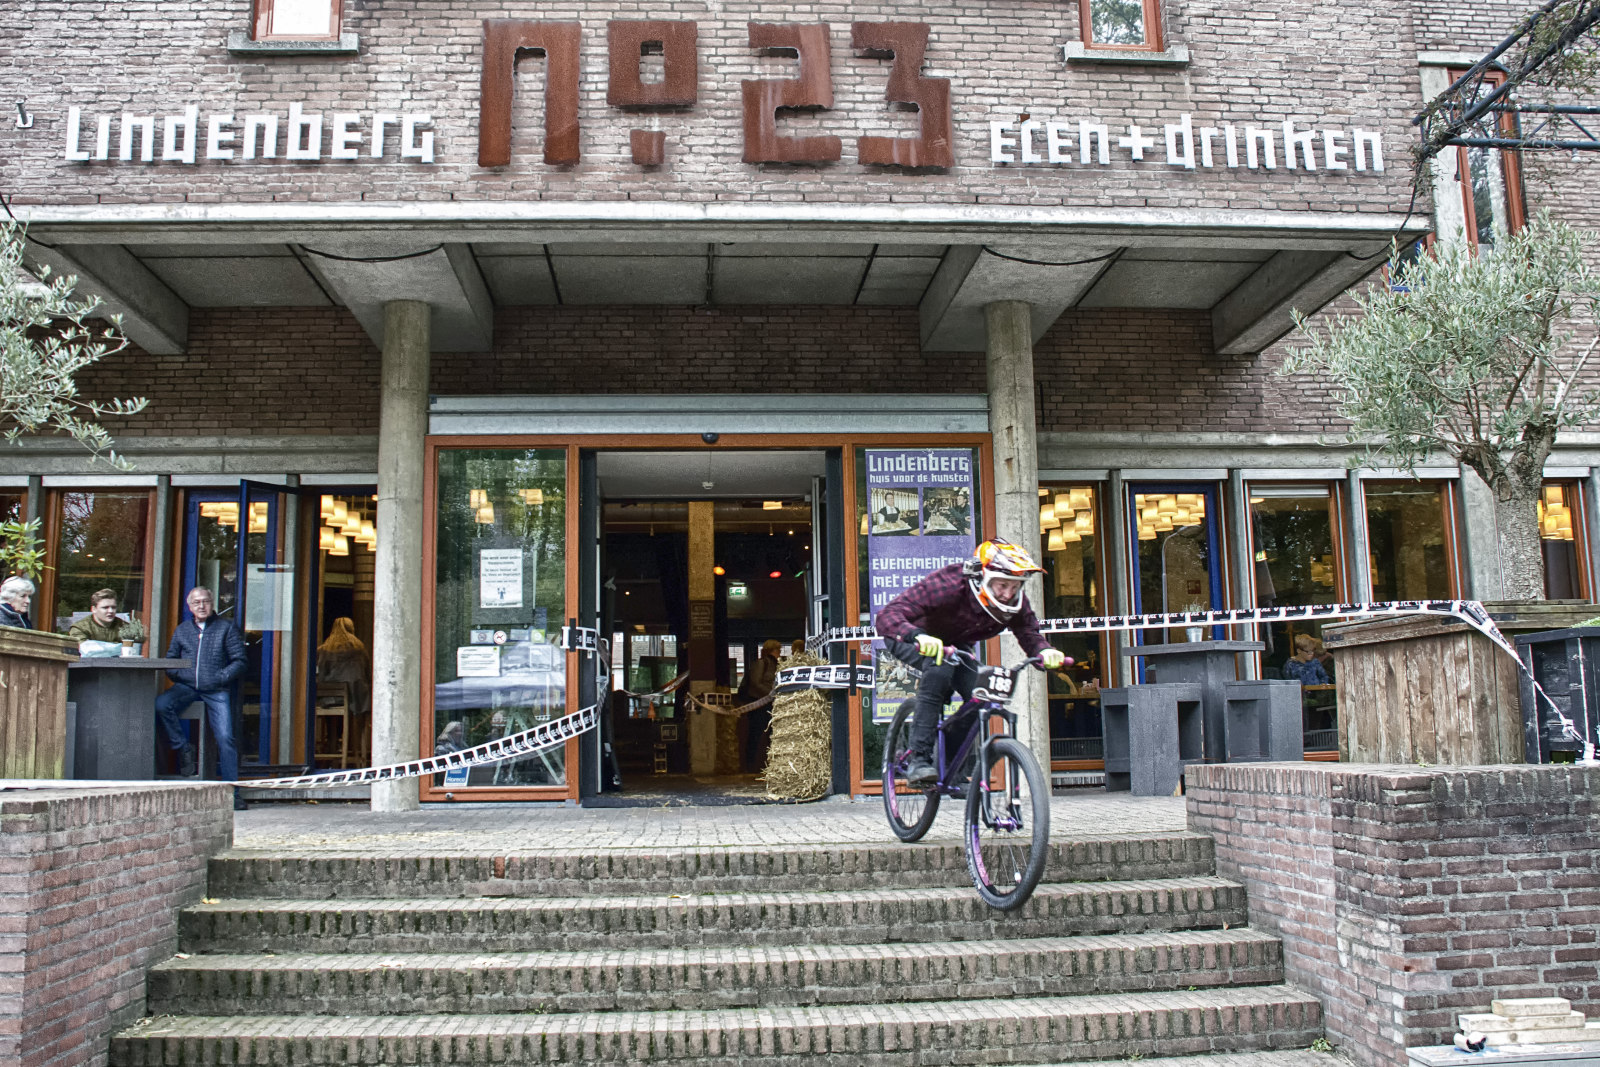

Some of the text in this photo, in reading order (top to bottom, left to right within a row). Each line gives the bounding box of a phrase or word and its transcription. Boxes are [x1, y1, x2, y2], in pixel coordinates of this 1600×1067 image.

[64, 103, 434, 163] Lindenberg
[869, 453, 969, 472] Lindenberg
[869, 473, 969, 483] huis voor de kunsten
[872, 574, 899, 588] met
